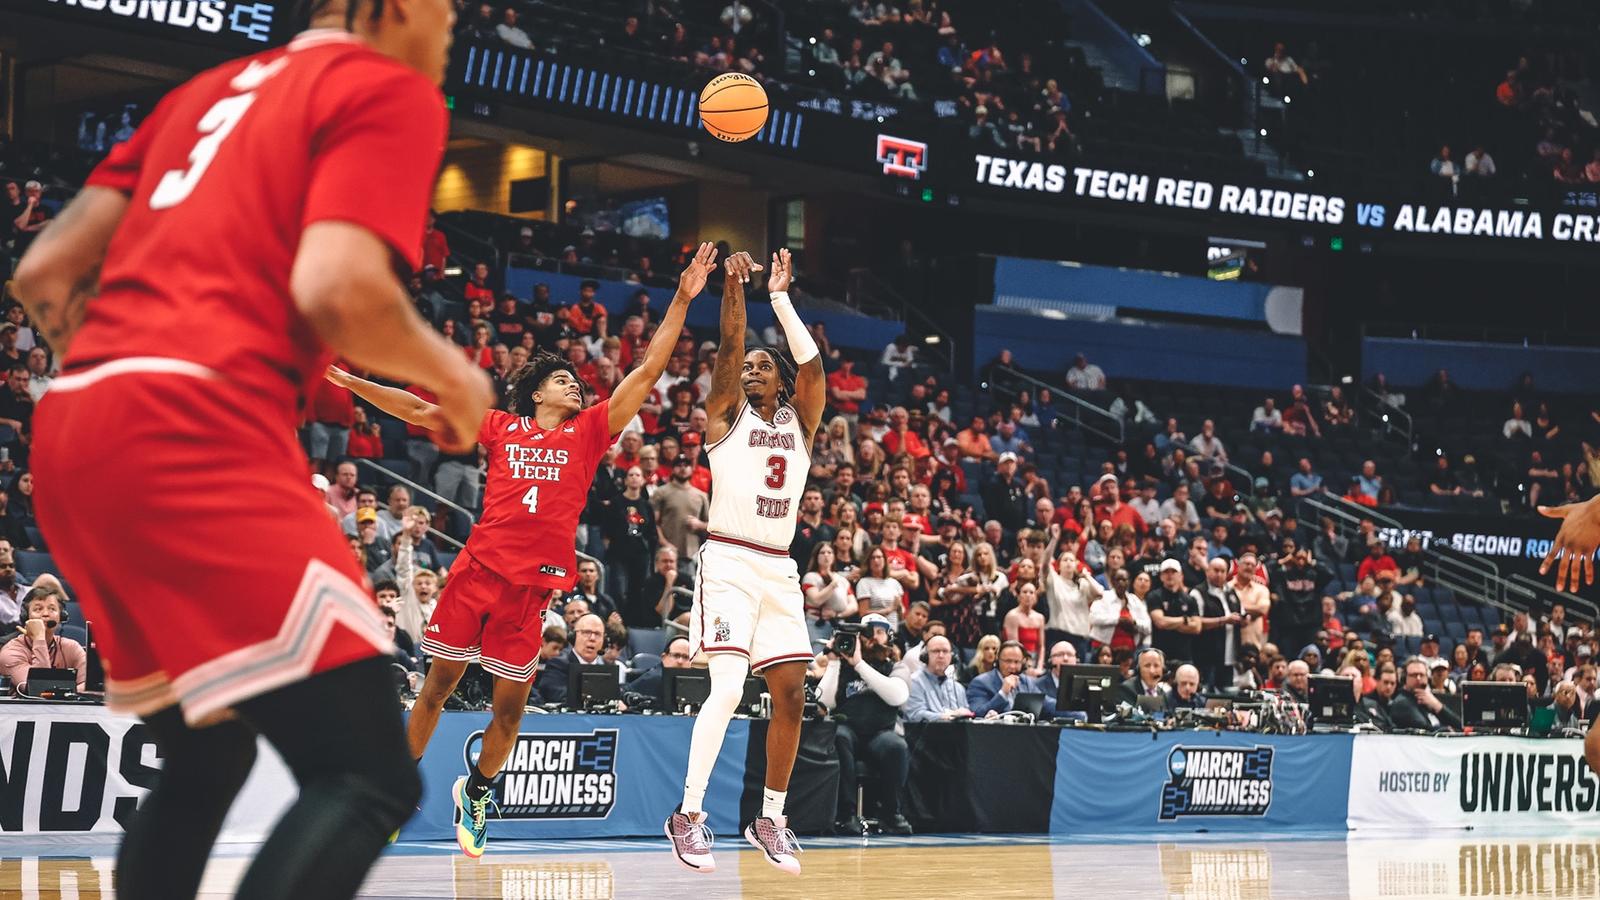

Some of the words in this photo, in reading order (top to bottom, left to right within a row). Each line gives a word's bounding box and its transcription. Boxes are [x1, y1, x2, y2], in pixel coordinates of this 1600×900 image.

[149, 91, 258, 210] 3
[975, 154, 1066, 193] TEXAS
[1074, 167, 1149, 203] TECH
[1155, 177, 1213, 210] RED
[1219, 185, 1345, 224] RAIDERS
[1356, 202, 1385, 228] VS
[1393, 204, 1543, 240] ALABAMA
[505, 444, 569, 465] TEXAS
[509, 461, 561, 482] TECH
[764, 454, 787, 491] 3
[521, 485, 539, 514] 4
[755, 494, 791, 519] TIDE
[1452, 532, 1521, 557] SECOND
[1185, 751, 1244, 778] MARCH
[503, 773, 614, 806] MADNESS
[1191, 779, 1270, 806] MADNESS
[1379, 771, 1430, 792] HOSTED
[1433, 772, 1450, 792] BY
[1459, 752, 1600, 812] UNIVERS
